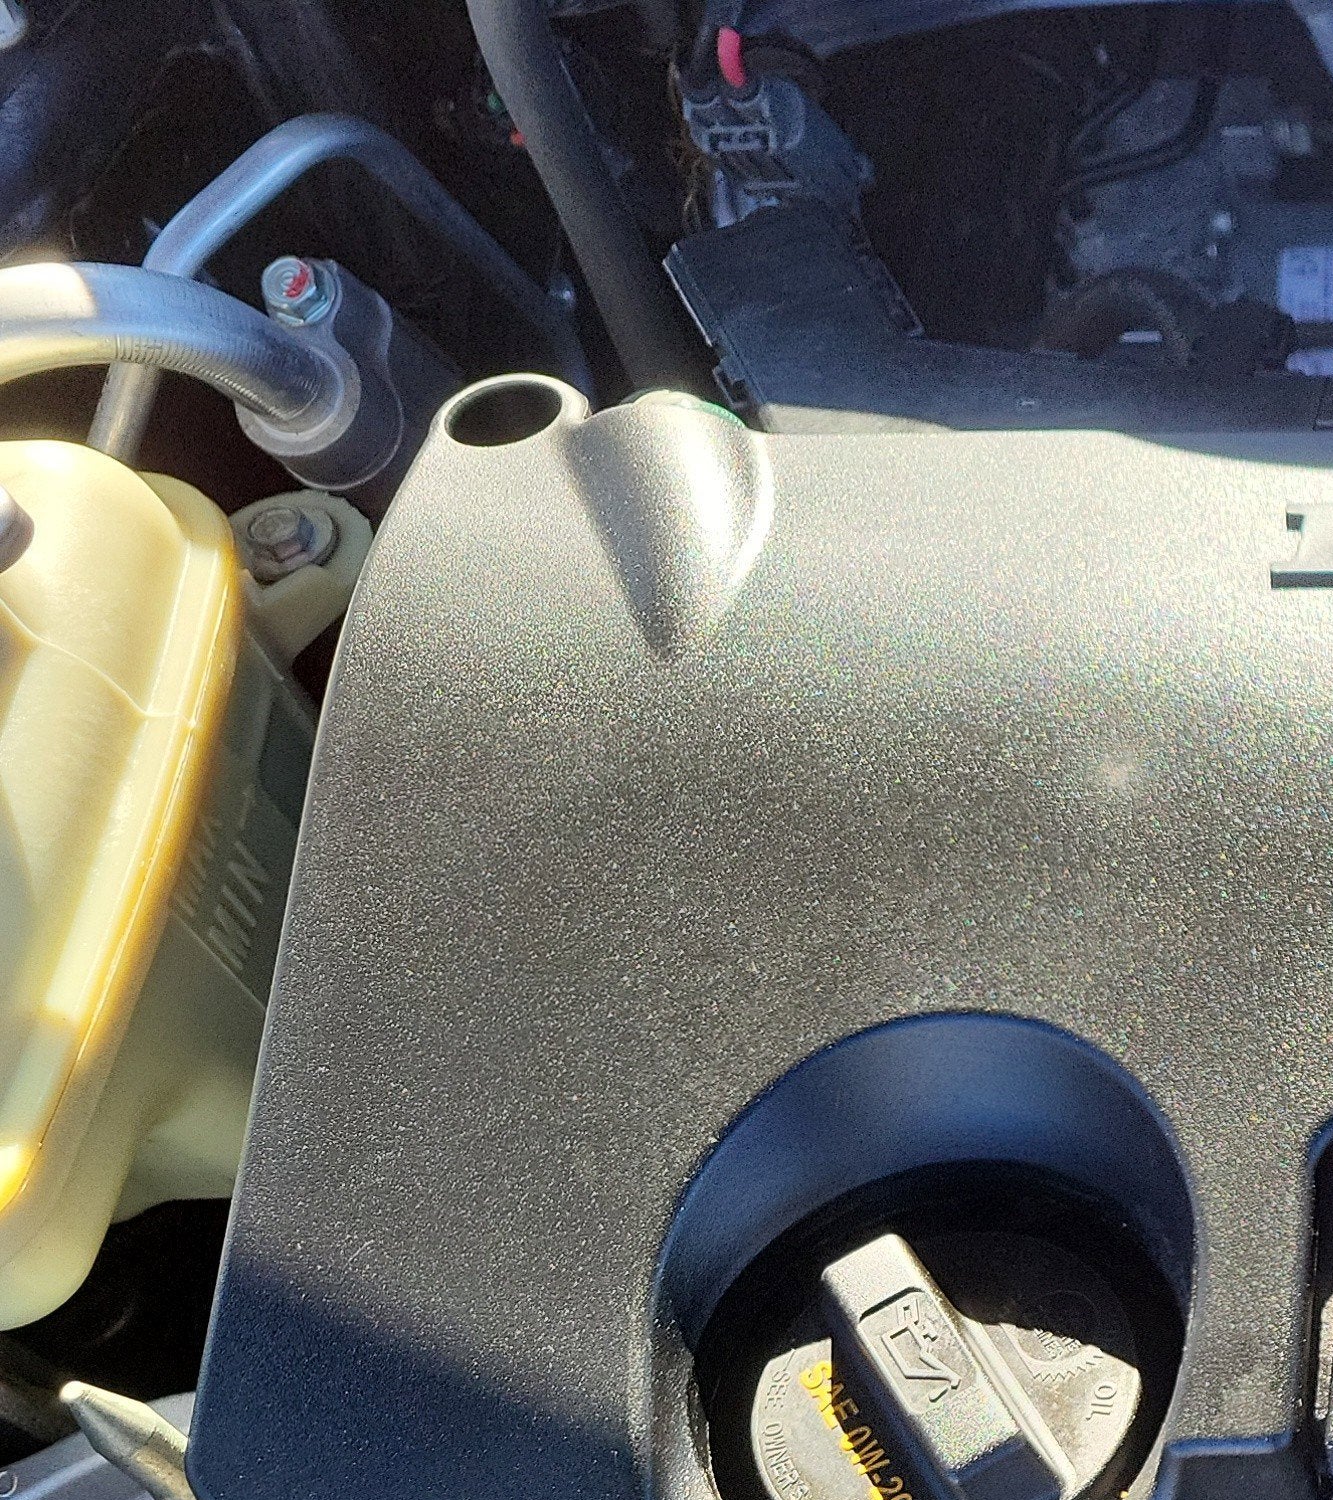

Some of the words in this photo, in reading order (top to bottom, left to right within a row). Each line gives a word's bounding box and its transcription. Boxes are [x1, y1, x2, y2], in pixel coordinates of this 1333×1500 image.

[765, 1367, 791, 1411] SEE
[799, 1360, 860, 1431] SAE
[1086, 1382, 1118, 1421] OIL
